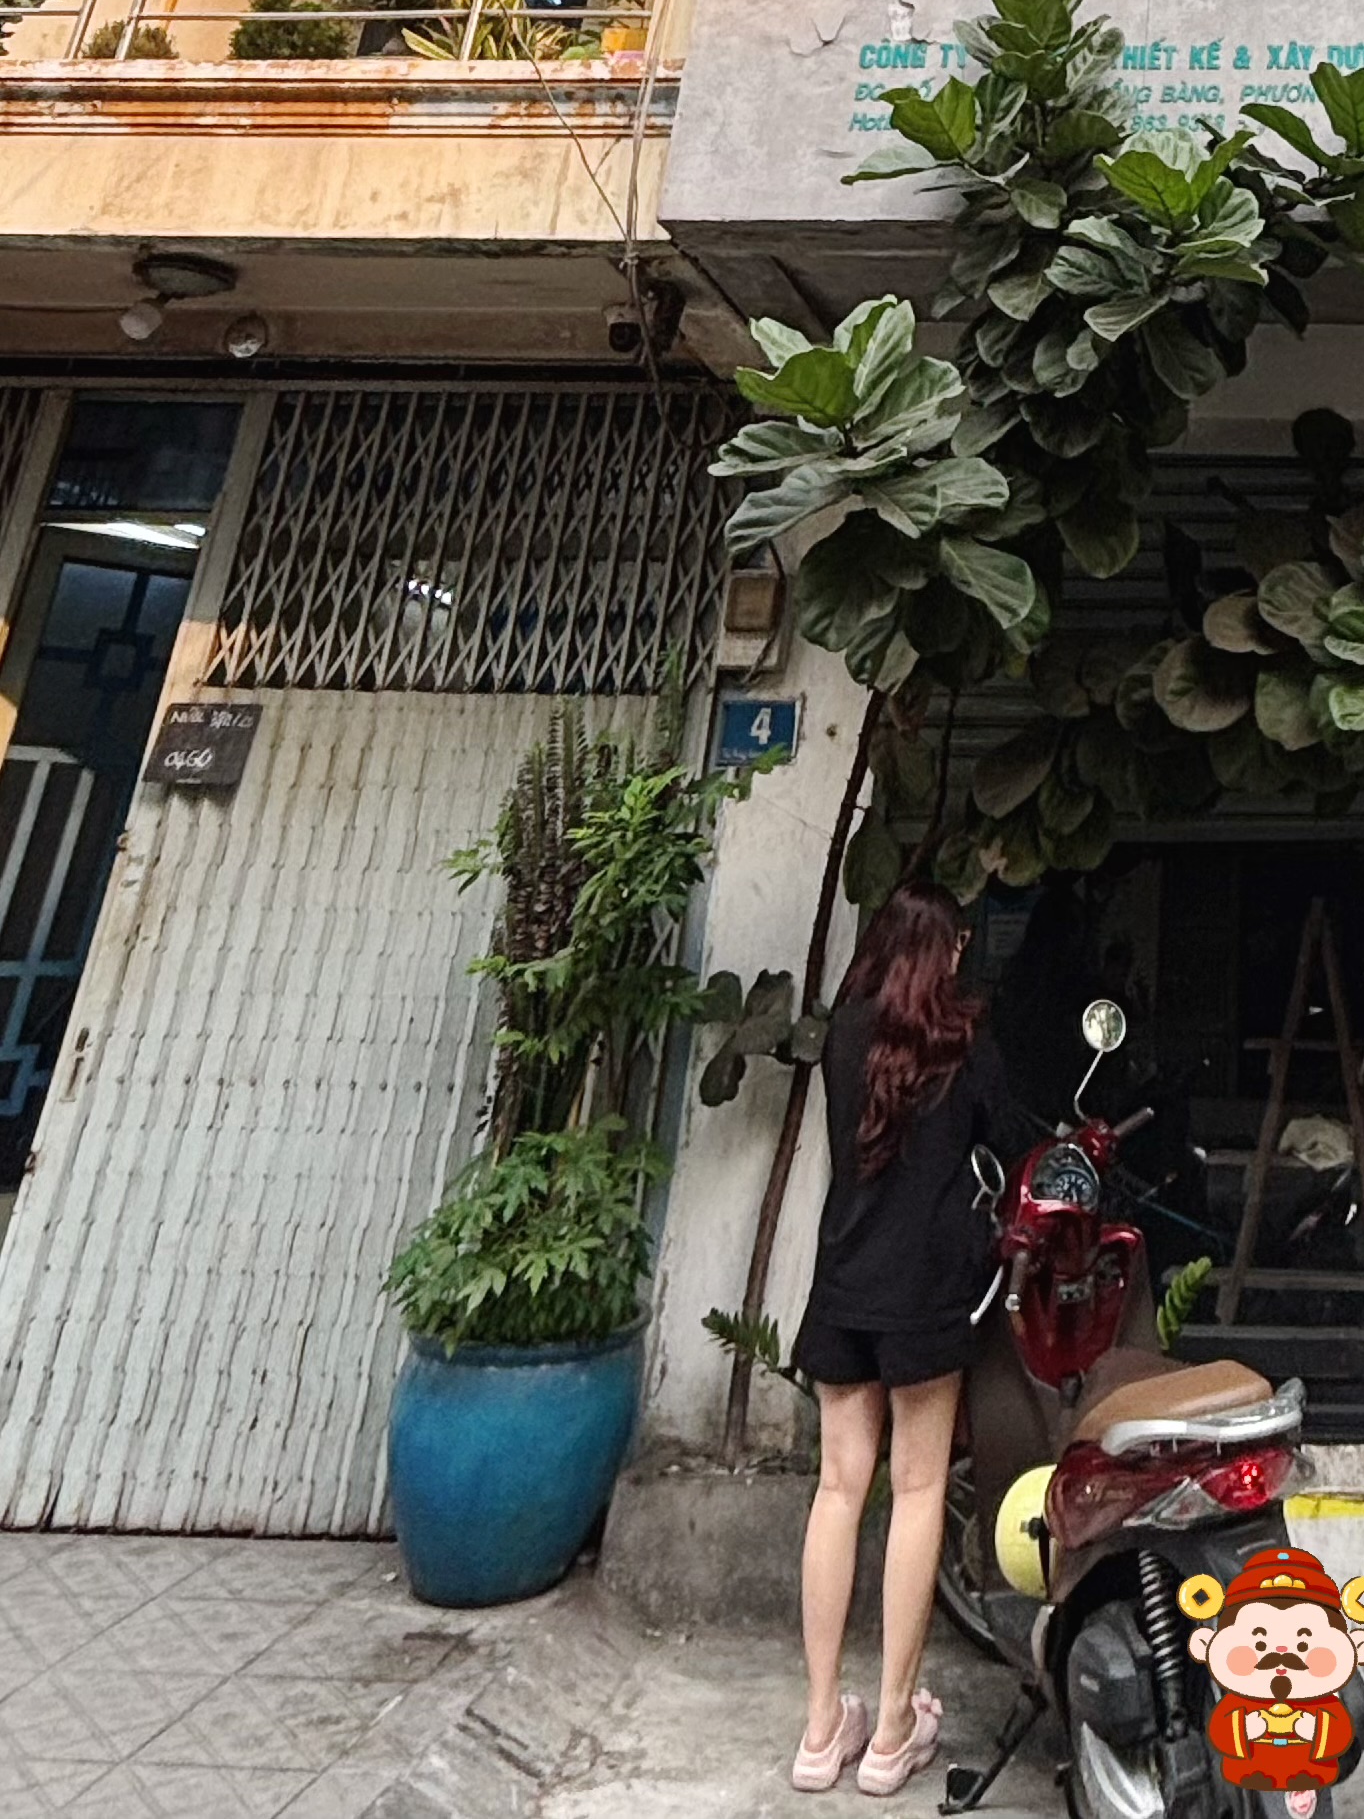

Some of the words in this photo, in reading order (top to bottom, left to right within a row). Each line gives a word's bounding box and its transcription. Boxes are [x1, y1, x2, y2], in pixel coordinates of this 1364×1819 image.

[859, 37, 928, 70] CÔNG
[940, 43, 967, 69] TY
[1111, 36, 1178, 70] HIẾT
[1188, 36, 1225, 70] KẾ
[1232, 44, 1252, 70] &
[1266, 39, 1316, 71] XÂY
[1159, 80, 1225, 105] BÀNG,
[749, 707, 772, 745] 4
